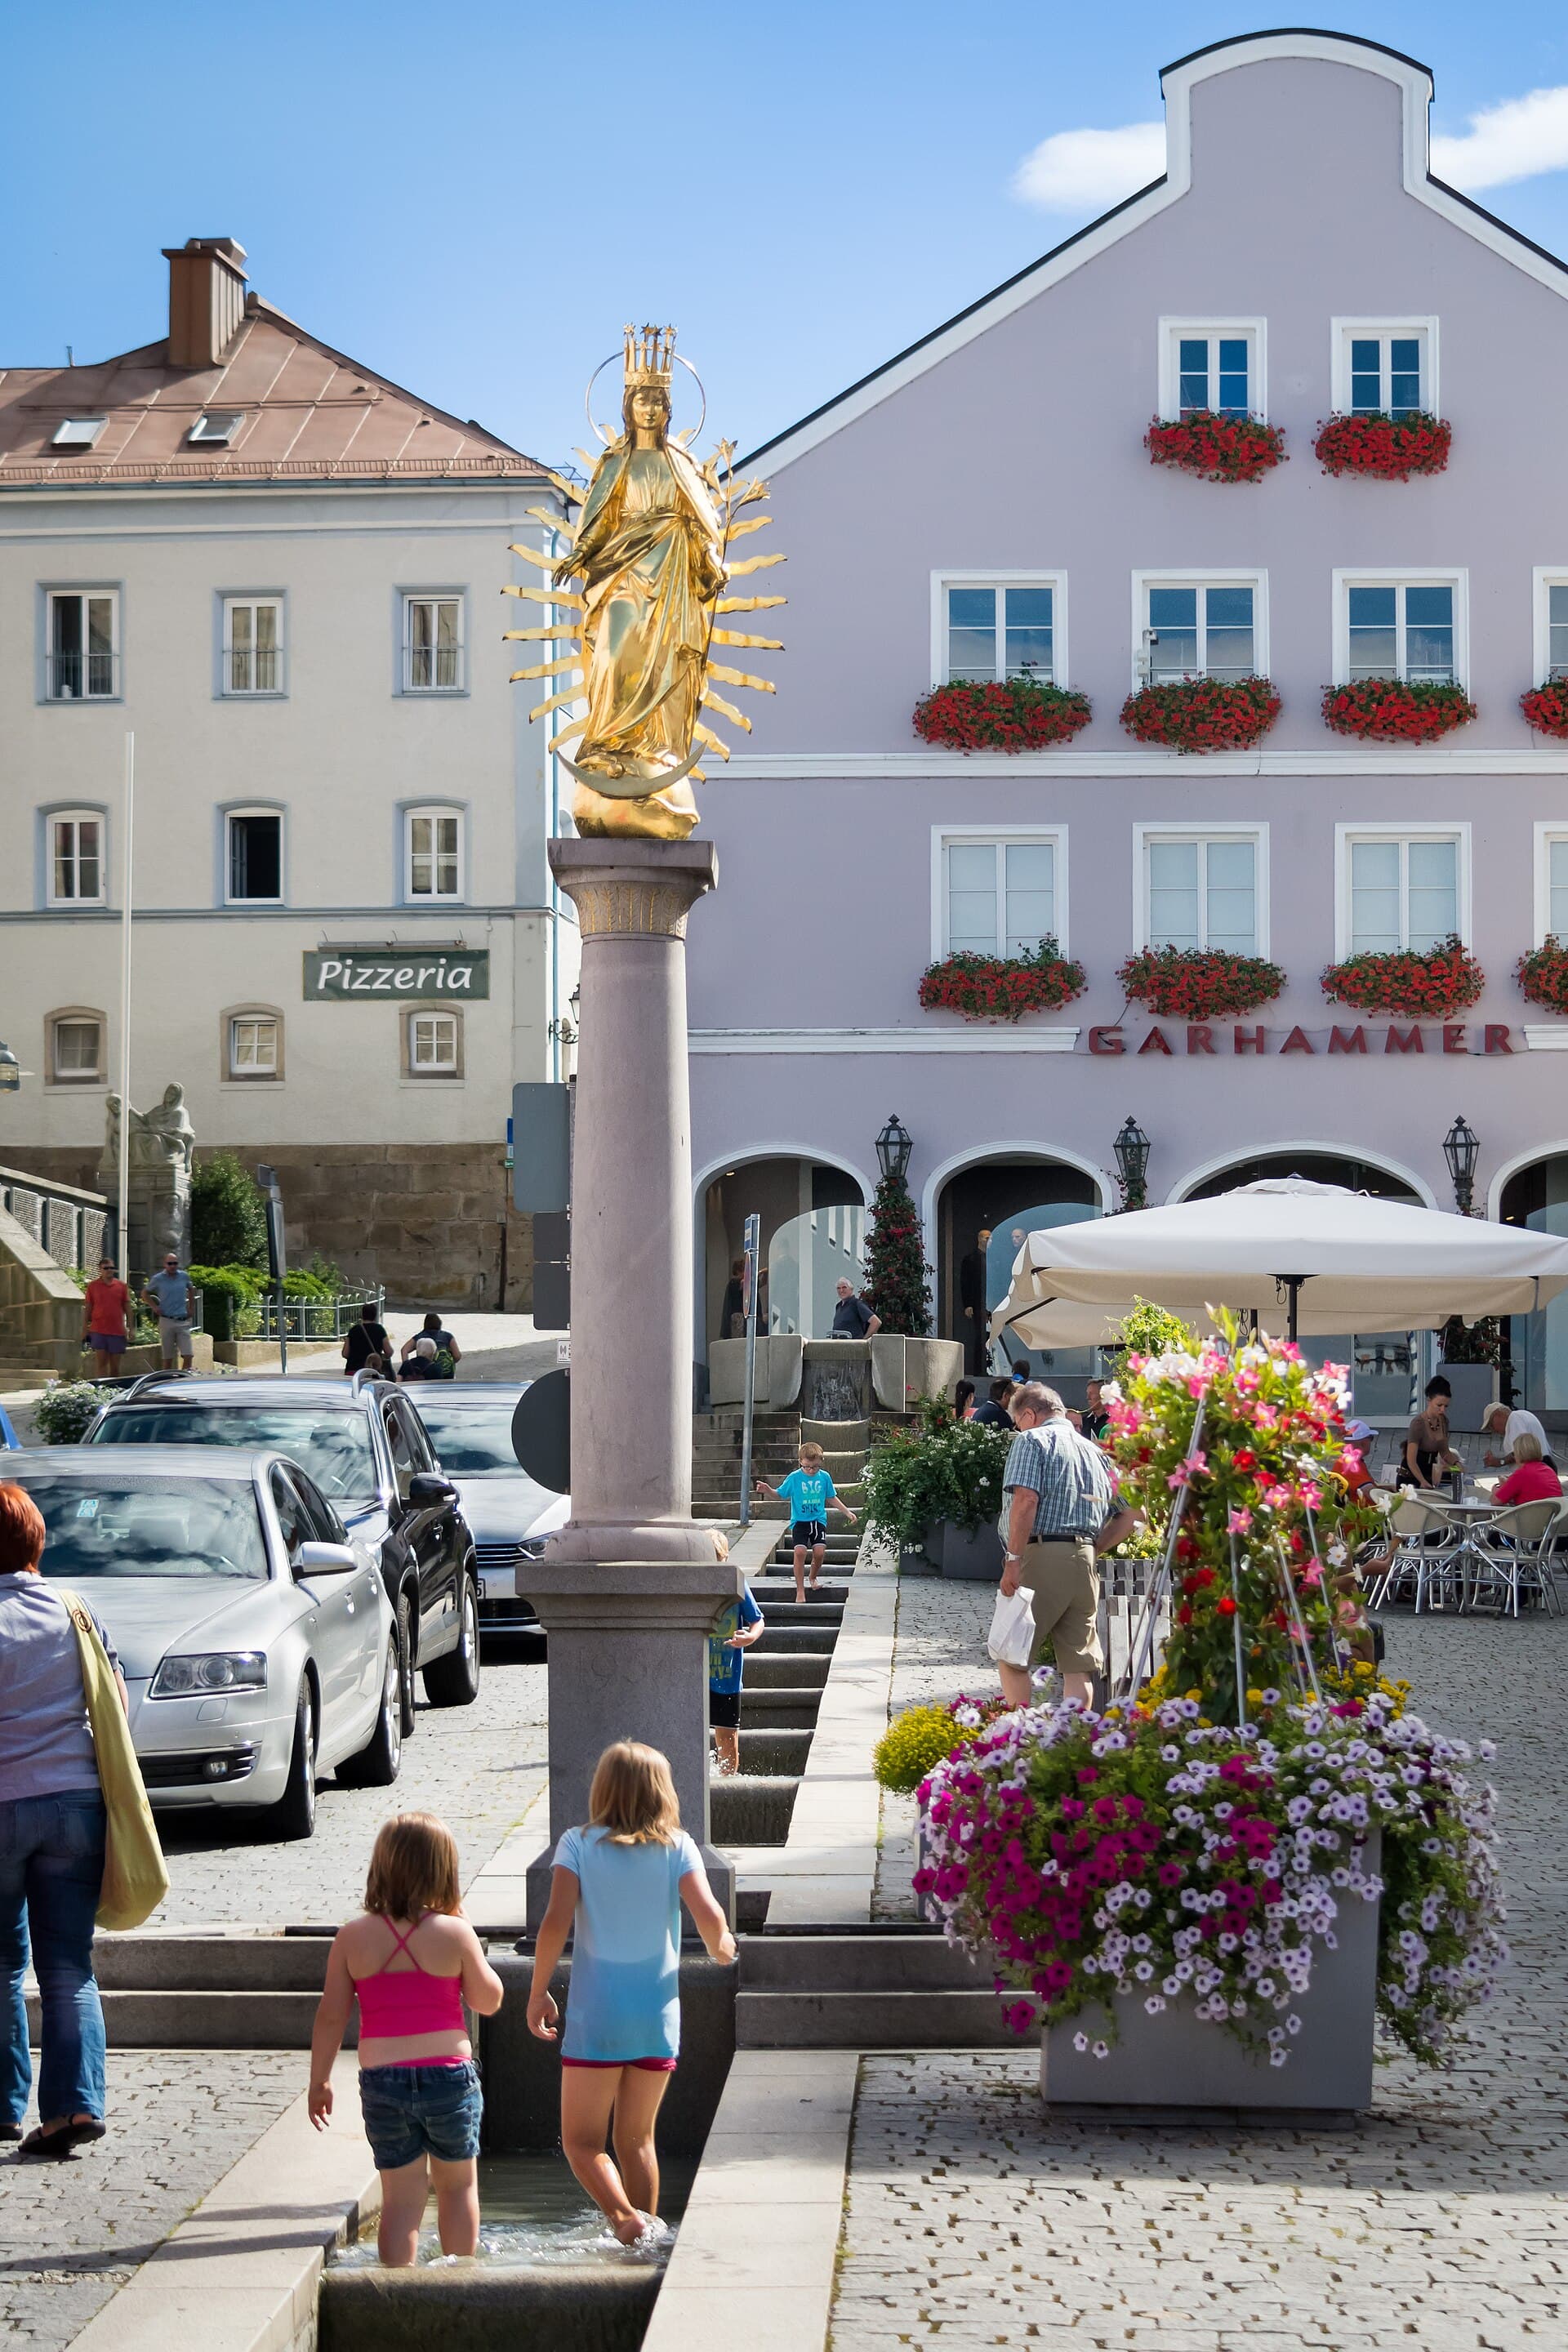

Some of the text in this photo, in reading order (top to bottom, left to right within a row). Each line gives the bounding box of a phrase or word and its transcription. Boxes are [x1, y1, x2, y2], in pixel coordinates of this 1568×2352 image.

[318, 958, 472, 990] Pizzeria
[1088, 1024, 1514, 1055] GARHAMMER
[801, 1481, 822, 1494] BIG
